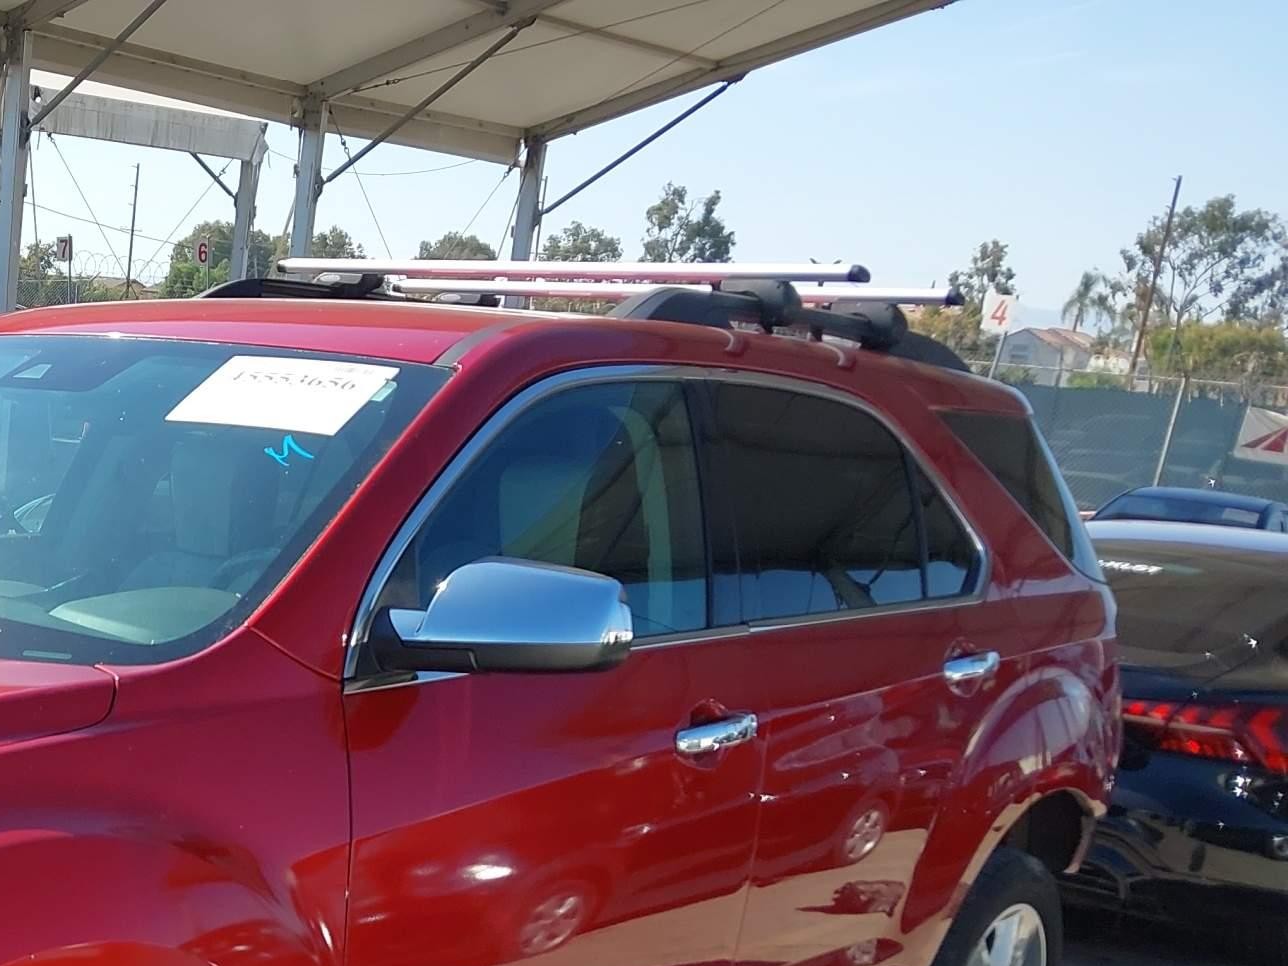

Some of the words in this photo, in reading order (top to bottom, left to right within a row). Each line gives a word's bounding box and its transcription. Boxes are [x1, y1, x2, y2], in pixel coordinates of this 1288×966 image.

[59, 239, 68, 259] 7
[198, 242, 208, 264] 6
[990, 300, 1007, 325] 4
